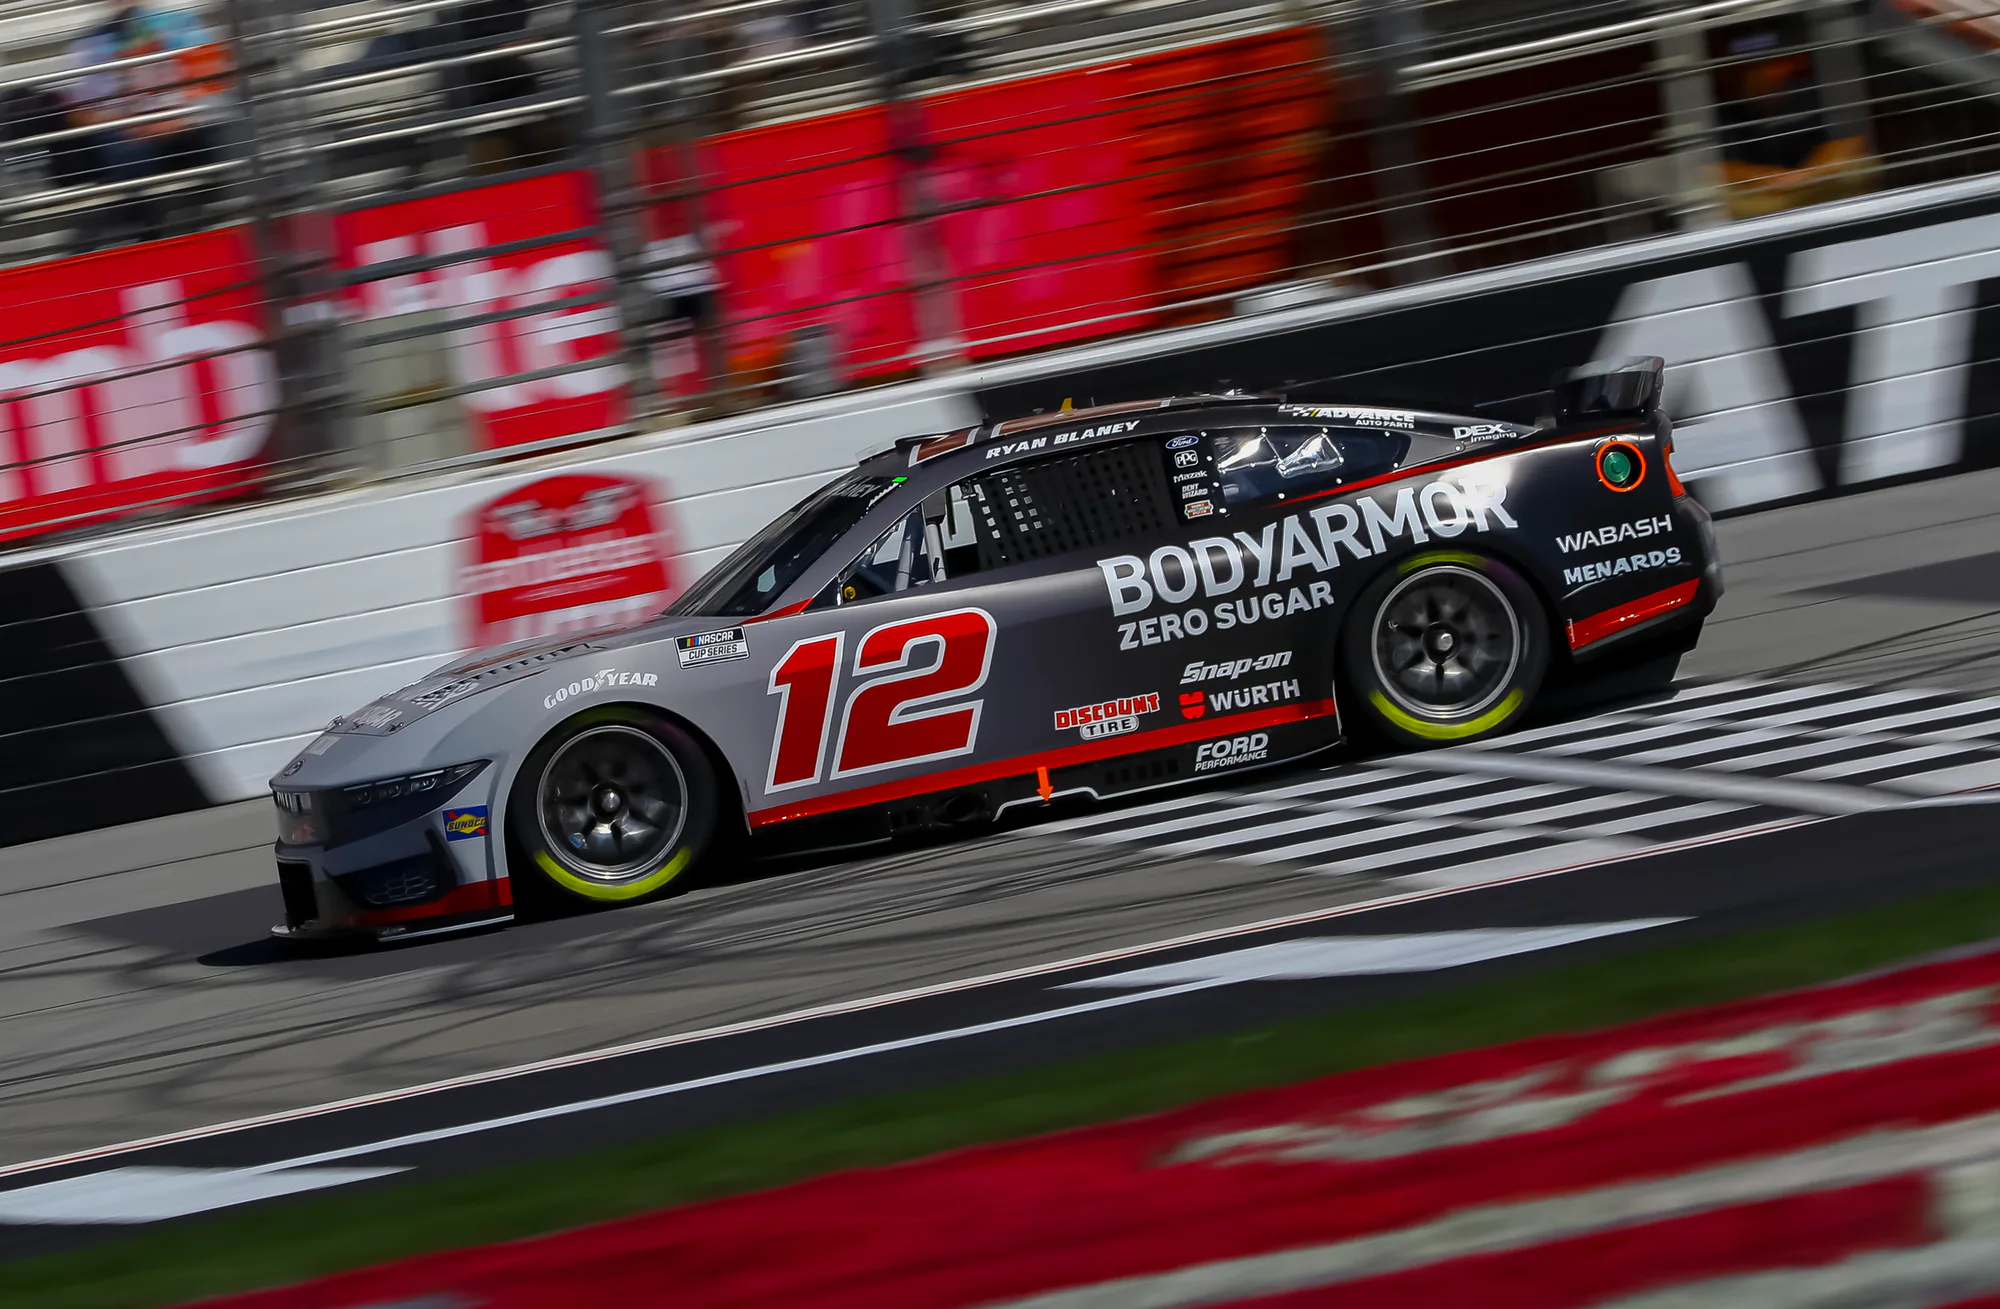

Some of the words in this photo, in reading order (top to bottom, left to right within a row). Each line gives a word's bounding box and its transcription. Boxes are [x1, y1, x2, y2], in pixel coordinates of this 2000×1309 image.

[1315, 408, 1415, 423] ADVANCE
[1355, 419, 1382, 427] AUTO
[1383, 420, 1415, 429] PARTS
[986, 437, 1047, 459] RYAN
[1053, 420, 1140, 444] BLANEY
[1172, 437, 1193, 447] Ford
[1453, 423, 1504, 440] DEX
[1176, 452, 1196, 466] PPG
[1173, 470, 1208, 483] Mazak
[1556, 513, 1673, 554] WABASH
[1097, 480, 1518, 617] BODYARMOR
[1563, 547, 1683, 585] MENARDS
[1117, 608, 1209, 651] ZERO
[1215, 580, 1335, 630] SUGAR
[698, 630, 734, 647] NASCAR
[688, 648, 706, 660] CUP
[707, 644, 738, 657] SERIES
[1179, 651, 1293, 685] Snap-on
[543, 668, 659, 710] GOODYEAR
[764, 607, 998, 795] 12
[1209, 679, 1300, 712] WÜRTH
[1055, 692, 1160, 731] DISCOUNT
[1086, 719, 1133, 736] TIRE
[1195, 749, 1268, 771] PERFORMANCE
[1196, 733, 1269, 762] FORD
[447, 814, 487, 833] SUNOCO
